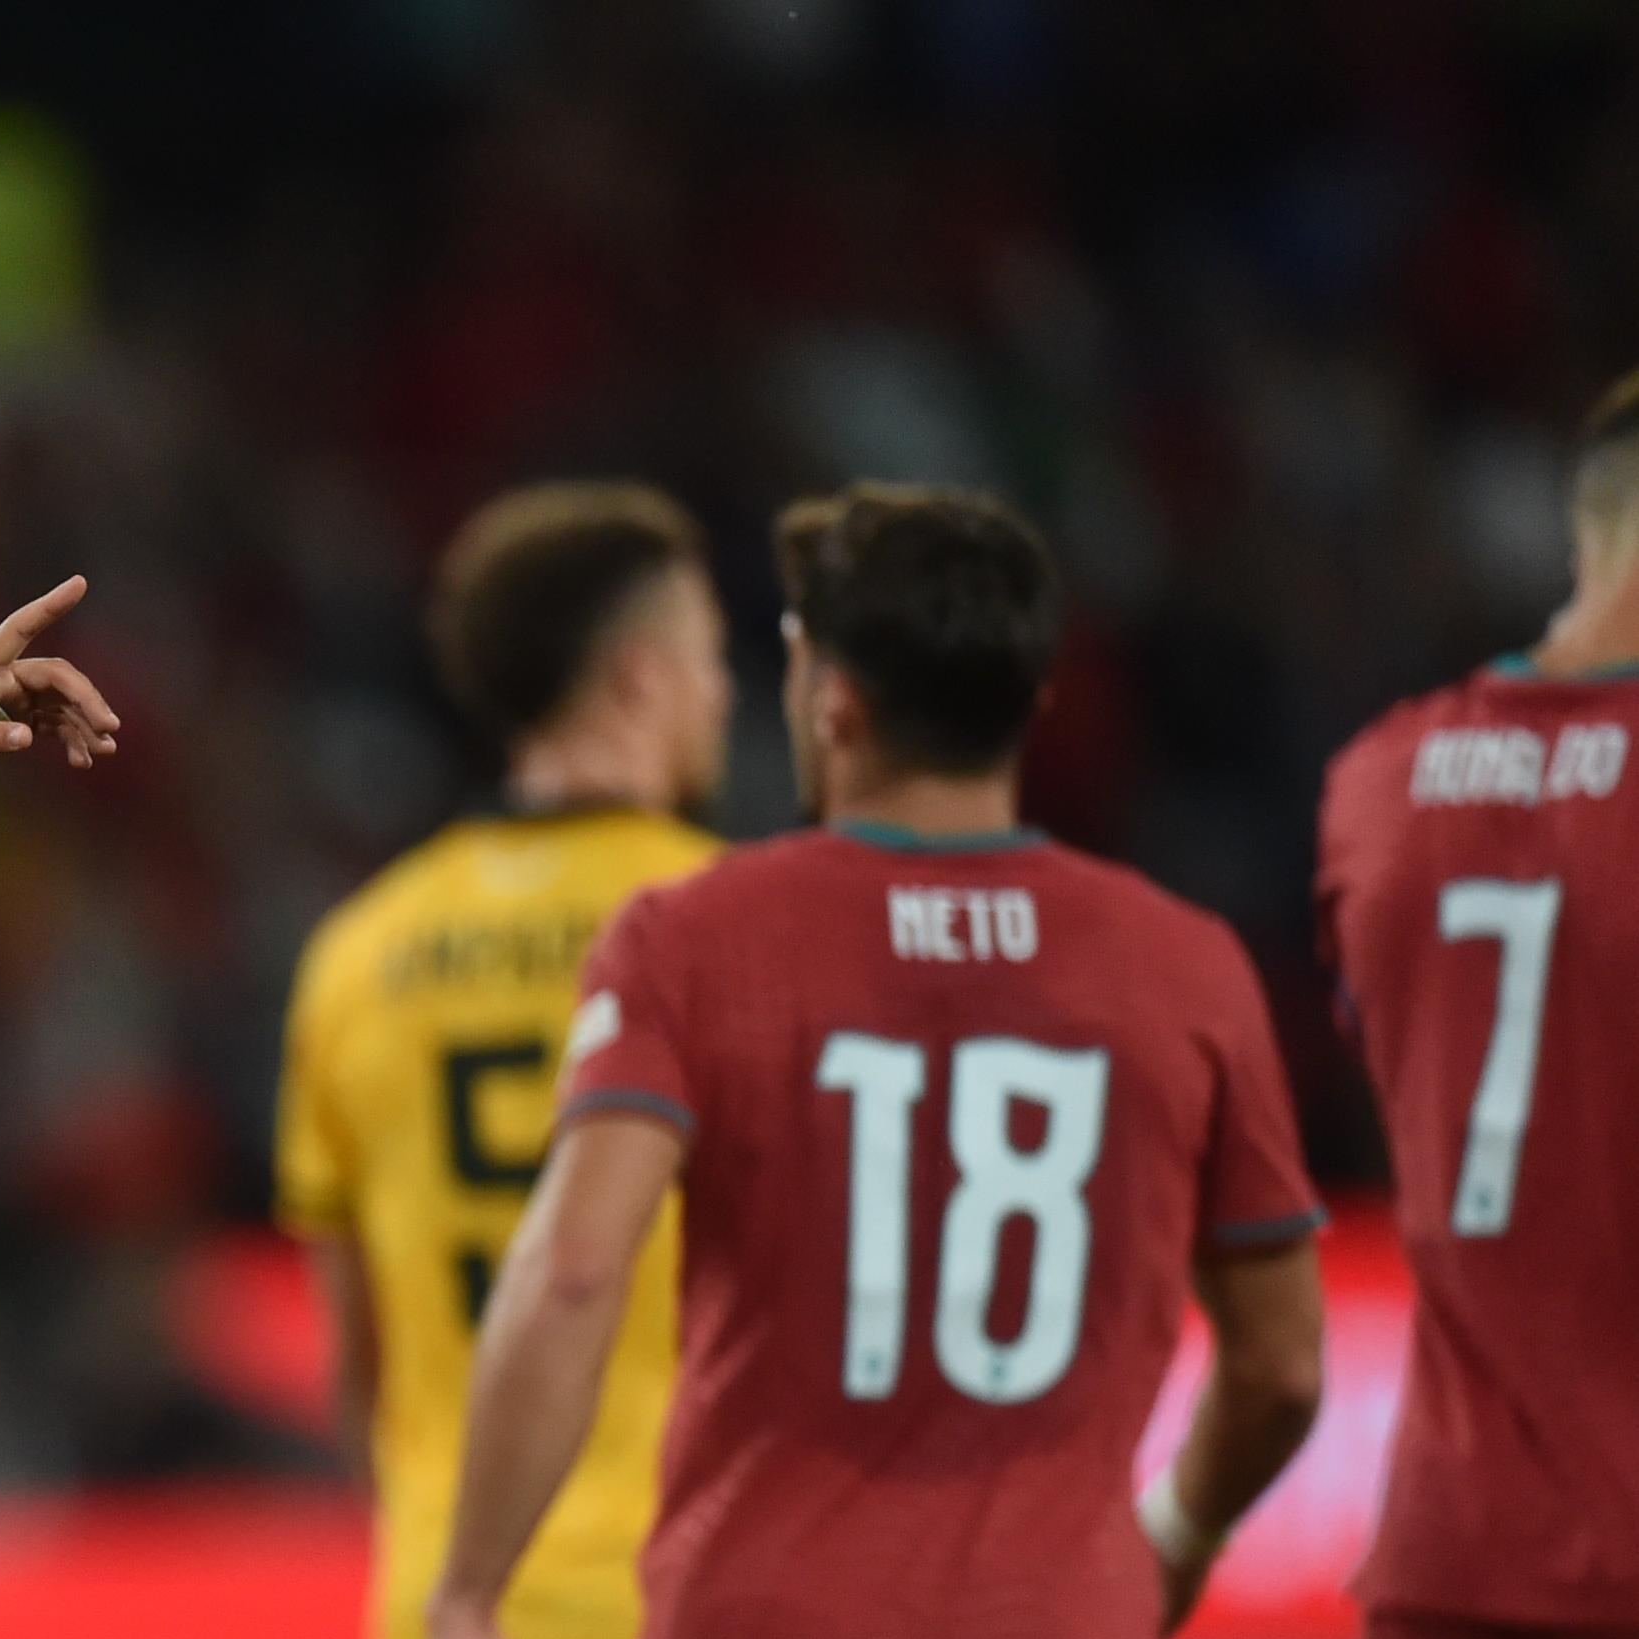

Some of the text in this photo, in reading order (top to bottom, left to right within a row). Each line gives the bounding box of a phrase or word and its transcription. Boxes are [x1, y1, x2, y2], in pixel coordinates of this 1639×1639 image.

[887, 888, 1039, 961] NETO
[1440, 879, 1559, 1236] 7
[817, 1031, 1109, 1402] 18
